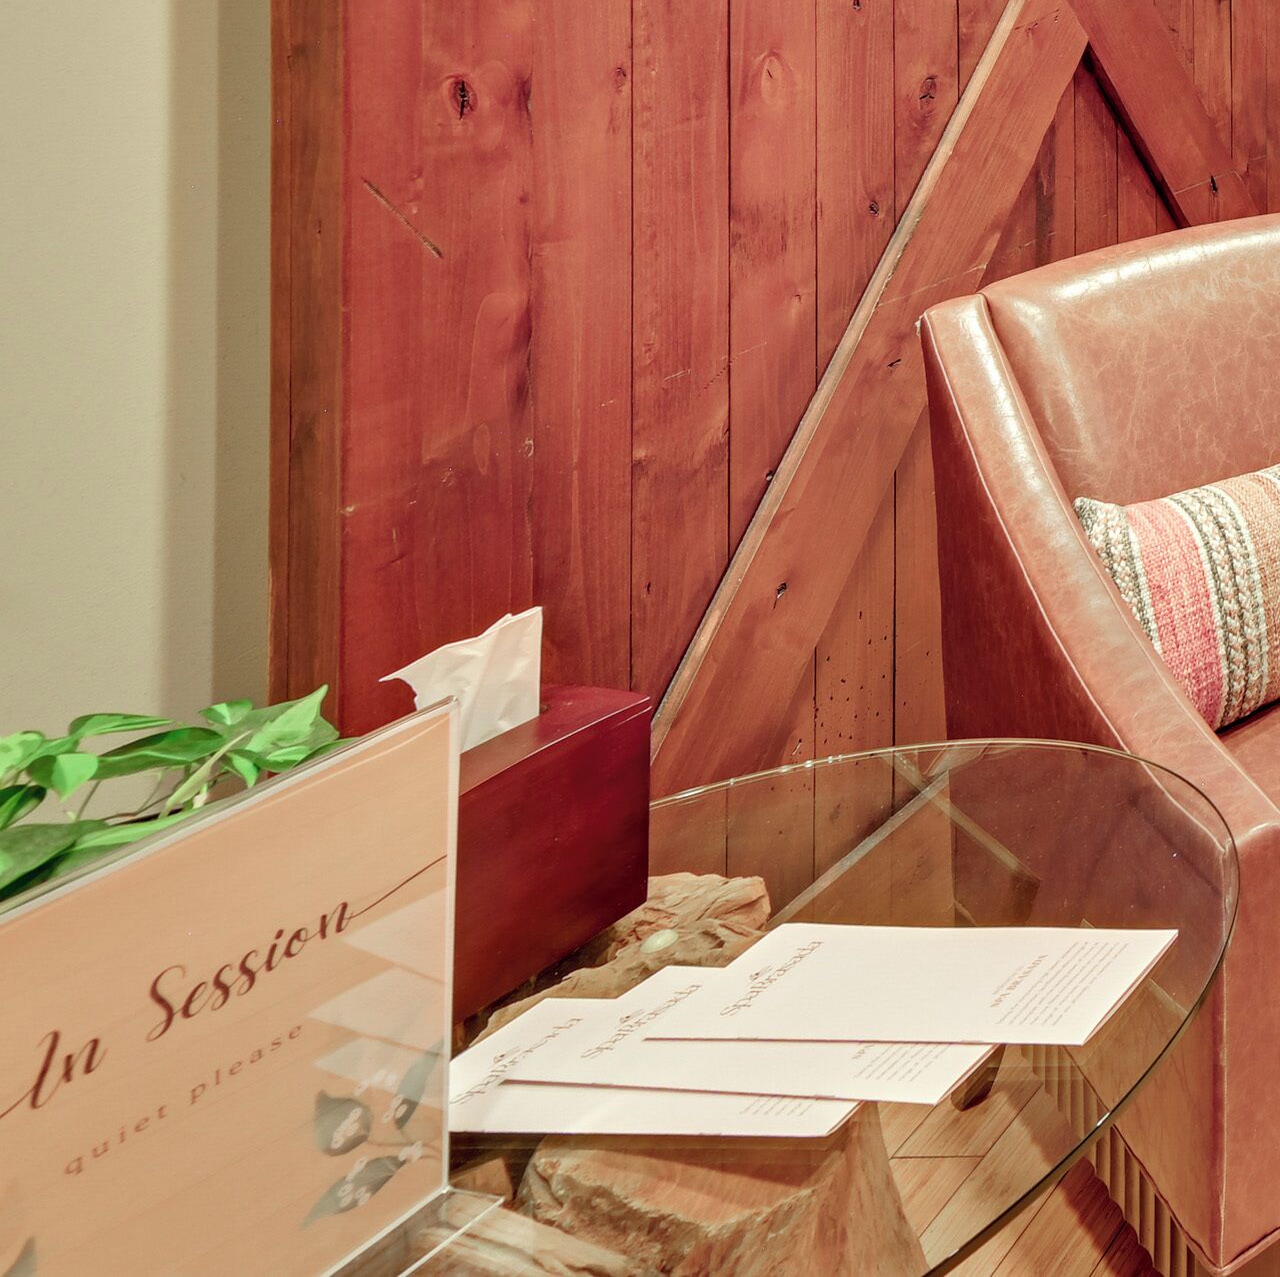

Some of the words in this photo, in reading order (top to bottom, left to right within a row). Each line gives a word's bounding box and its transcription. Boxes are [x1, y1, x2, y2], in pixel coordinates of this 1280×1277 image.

[10, 1030, 107, 1117] In
[145, 877, 412, 1042] Session
[580, 984, 702, 1058] SpaBrasada
[720, 940, 824, 1017] SpaBrasada
[64, 1103, 168, 1178] quiet
[188, 1025, 304, 1106] please
